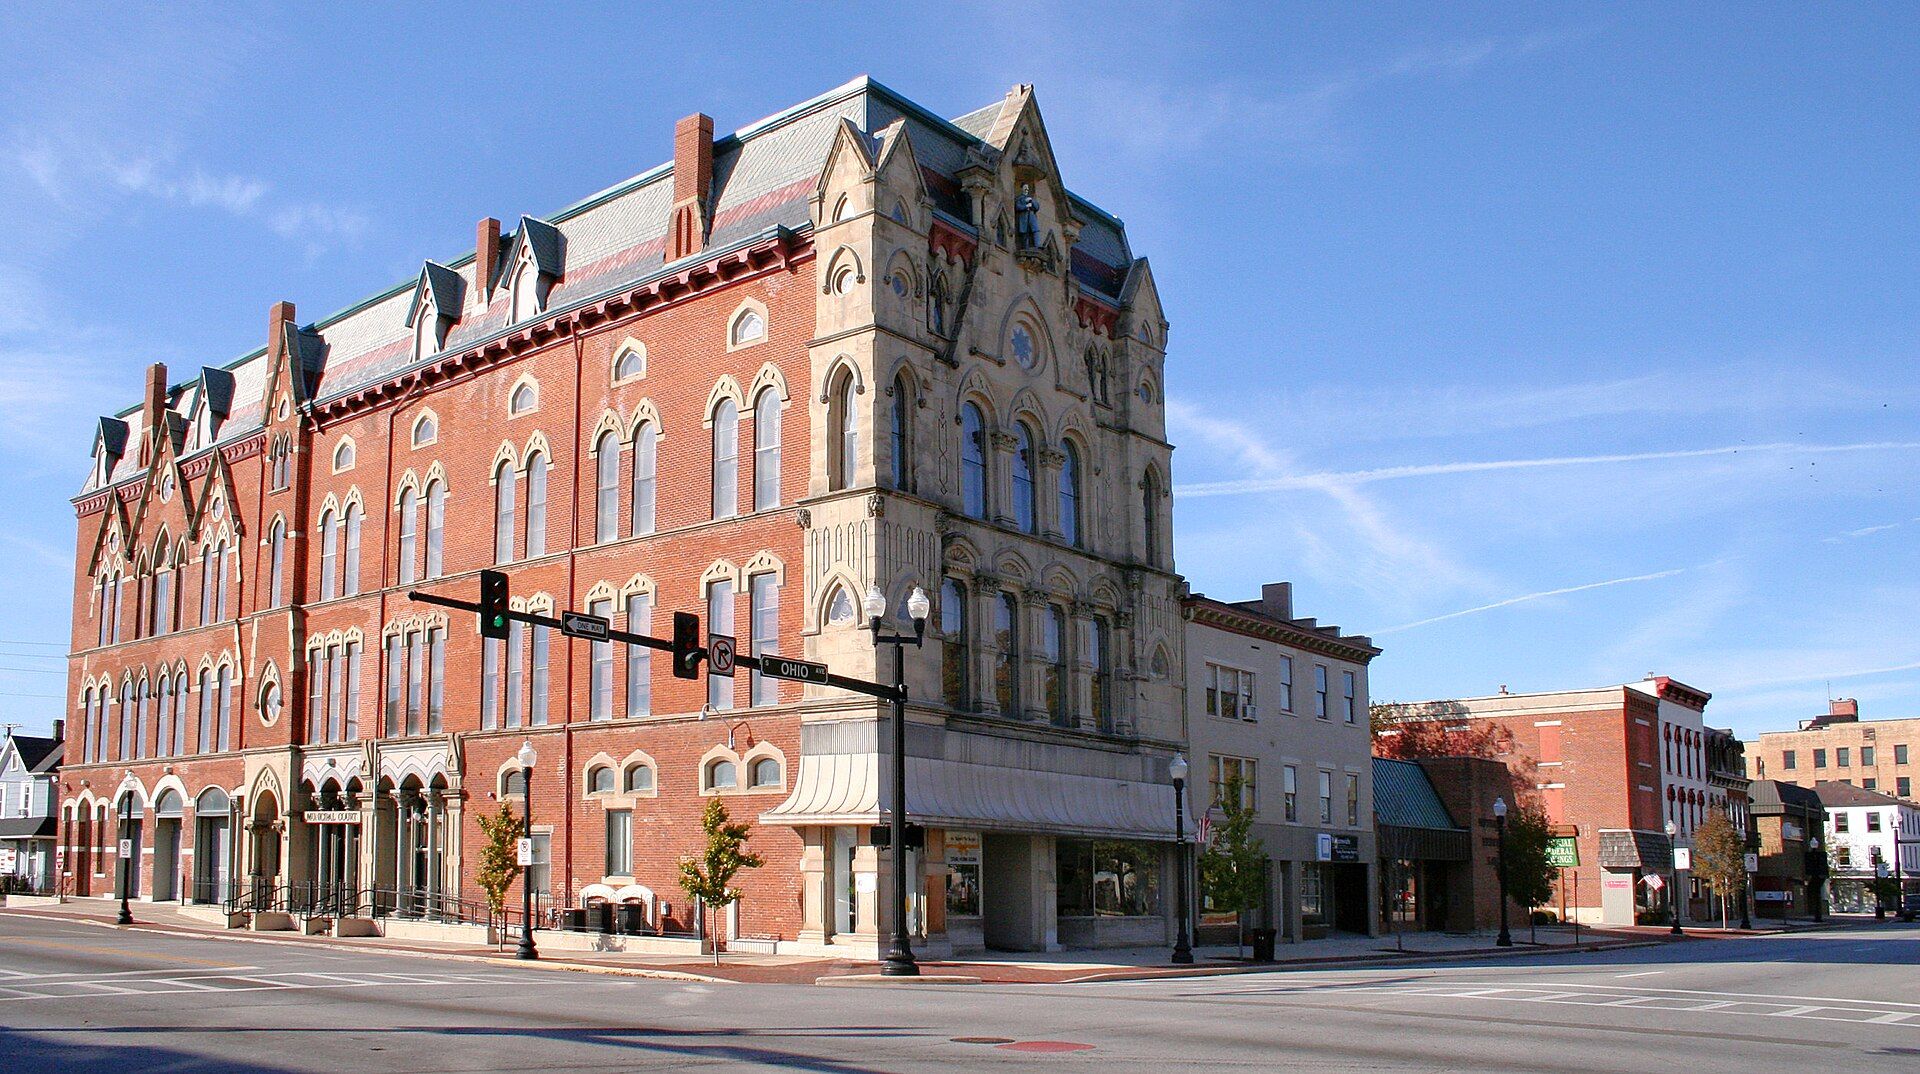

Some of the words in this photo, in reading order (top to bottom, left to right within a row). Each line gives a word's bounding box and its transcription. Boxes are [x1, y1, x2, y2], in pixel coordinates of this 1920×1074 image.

[577, 621, 589, 631] ONE
[591, 624, 603, 632] WAY
[781, 662, 809, 678] OHIO
[815, 667, 825, 675] AVE
[306, 812, 336, 821] MUNICIPAL
[338, 812, 358, 821] COURT
